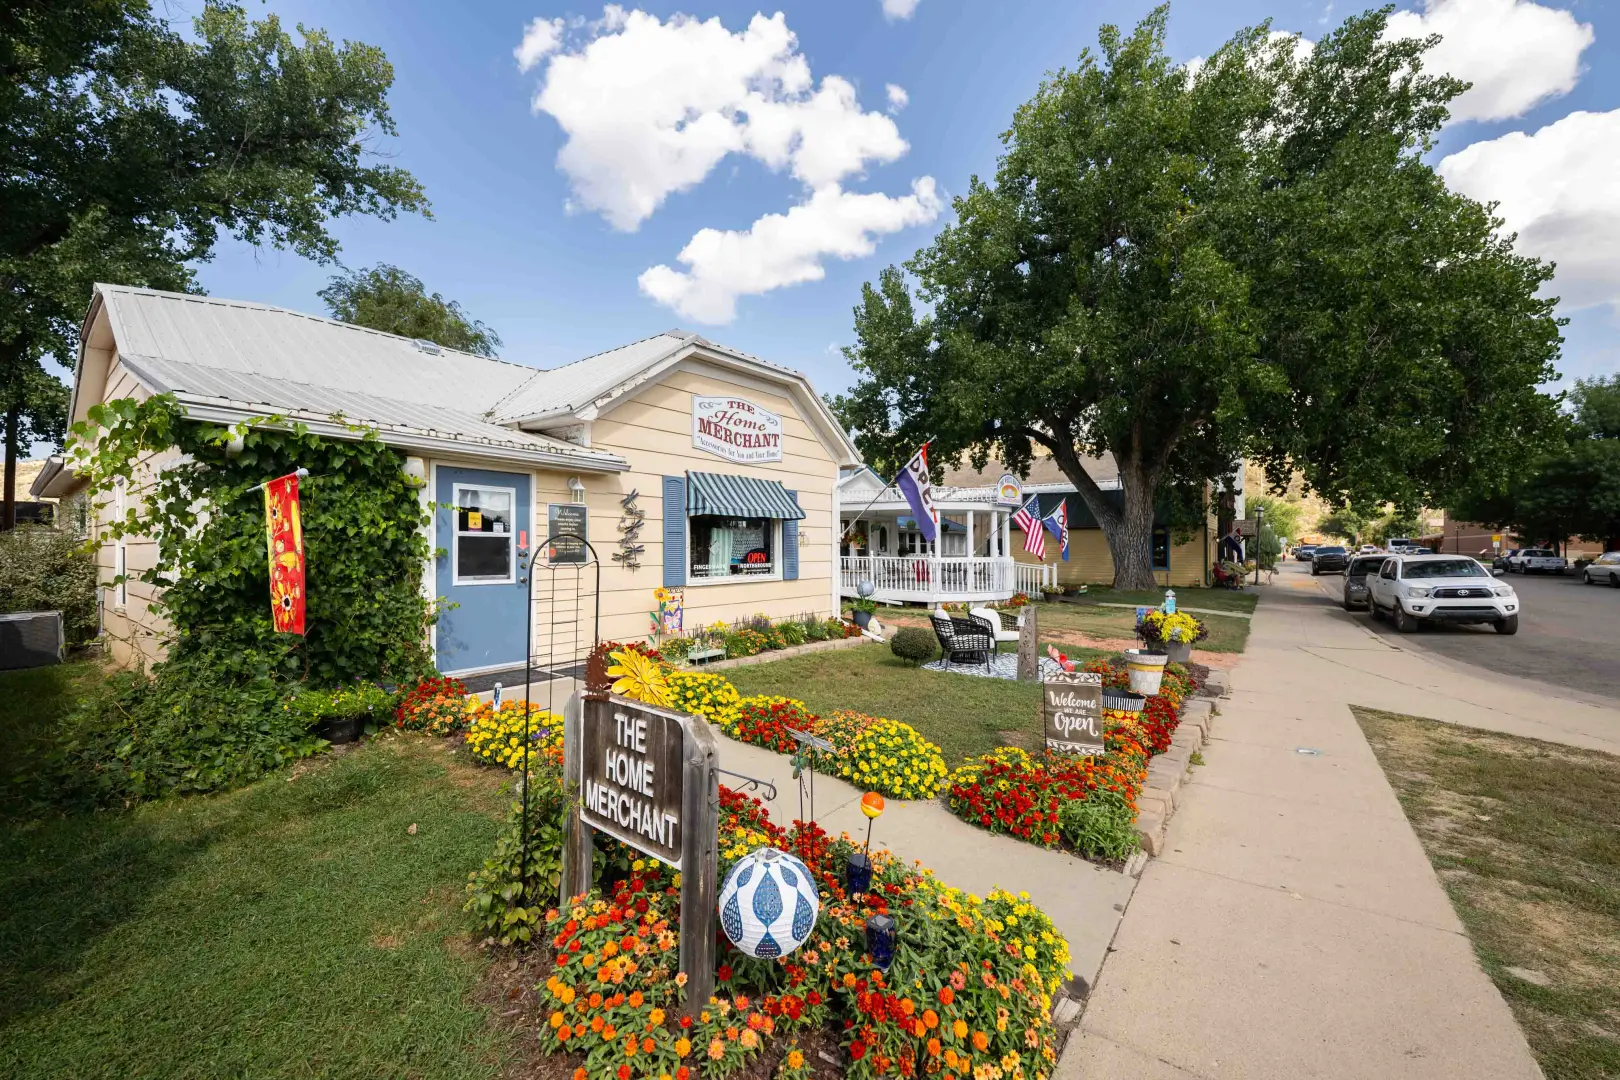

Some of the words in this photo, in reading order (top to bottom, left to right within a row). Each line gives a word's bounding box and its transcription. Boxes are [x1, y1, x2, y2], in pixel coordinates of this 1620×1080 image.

[727, 400, 755, 415] THE
[698, 417, 780, 448] MERCHANT
[708, 411, 767, 431] Home
[747, 552, 767, 563] OPEN
[1049, 690, 1097, 709] Welcome
[1074, 708, 1087, 716] ARE
[614, 712, 648, 754] THE
[1054, 711, 1099, 738] Open
[605, 748, 655, 798] HOME
[585, 779, 679, 849] MERCHANT
